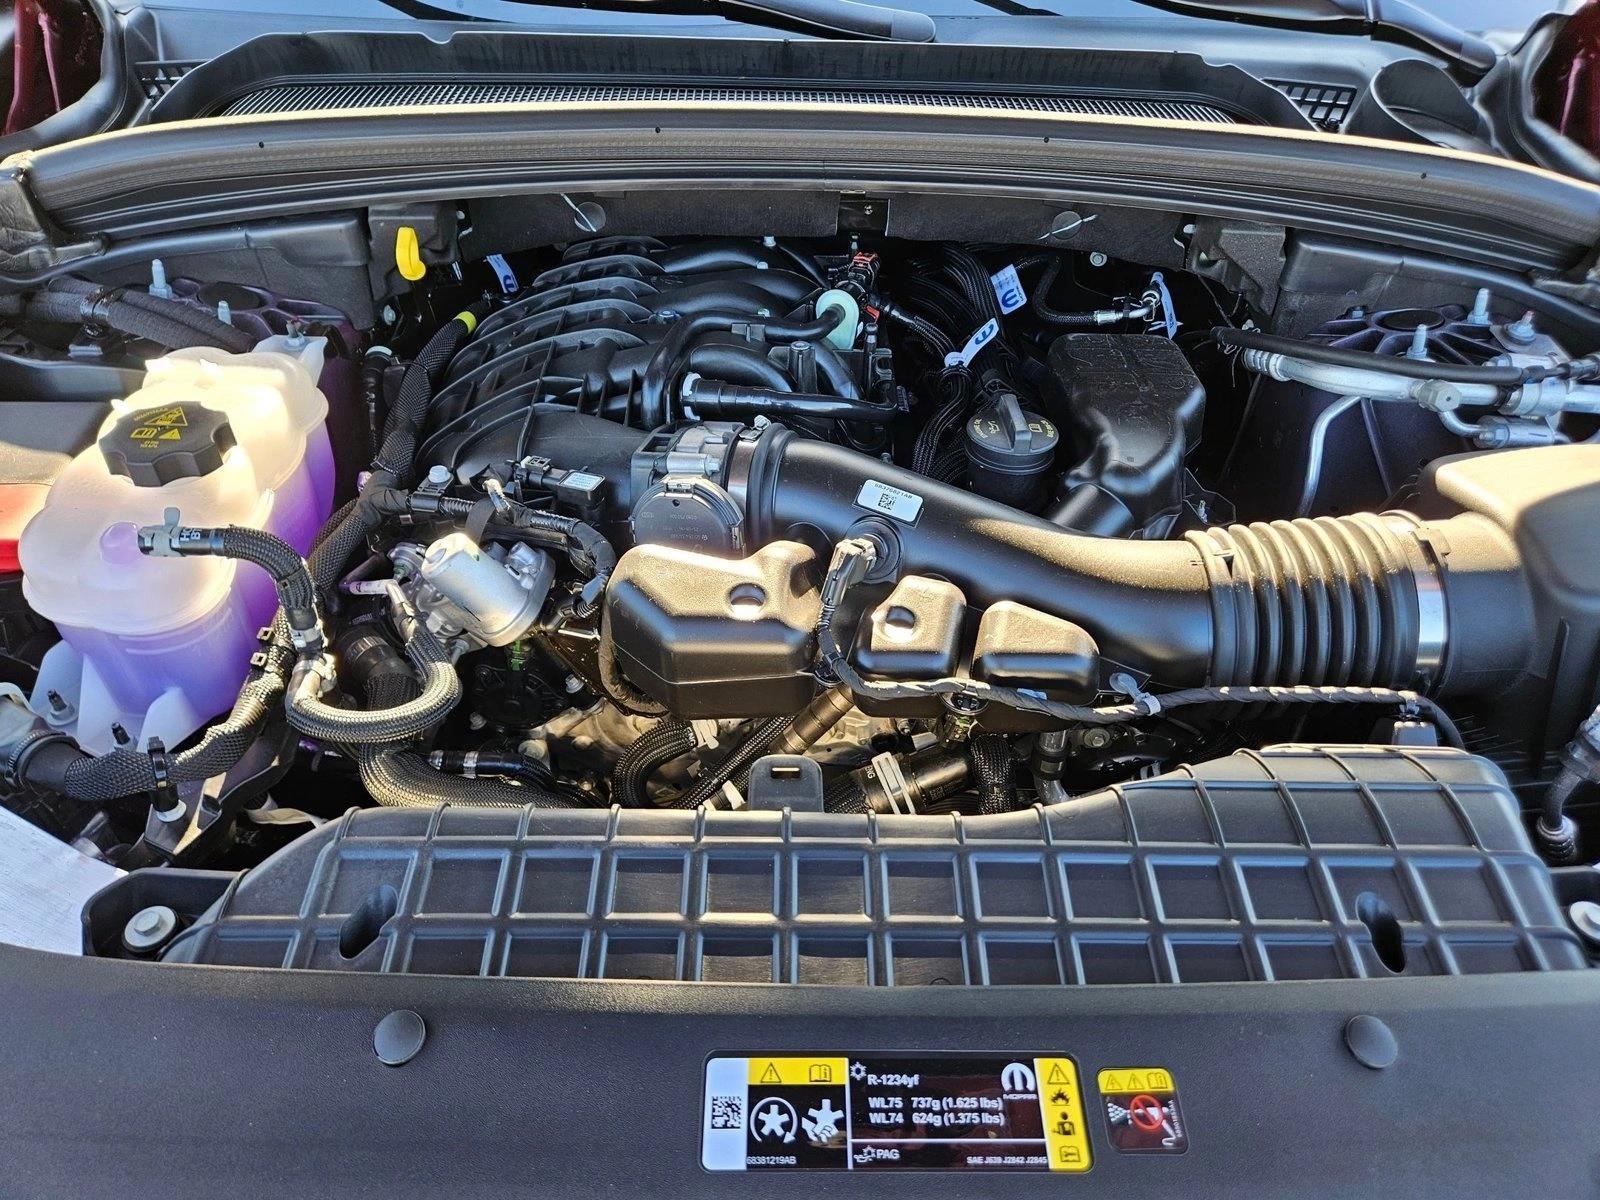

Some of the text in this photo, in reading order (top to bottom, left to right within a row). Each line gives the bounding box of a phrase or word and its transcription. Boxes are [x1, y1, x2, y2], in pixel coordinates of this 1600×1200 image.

[867, 1074, 920, 1088] R-1234yf
[868, 1097, 1003, 1111] WL75 737g (1.625 lbs)
[869, 1113, 1005, 1127] WL74 624g (1.375 lbs)
[876, 1149, 900, 1160] PAG
[966, 1156, 984, 1164] SAE
